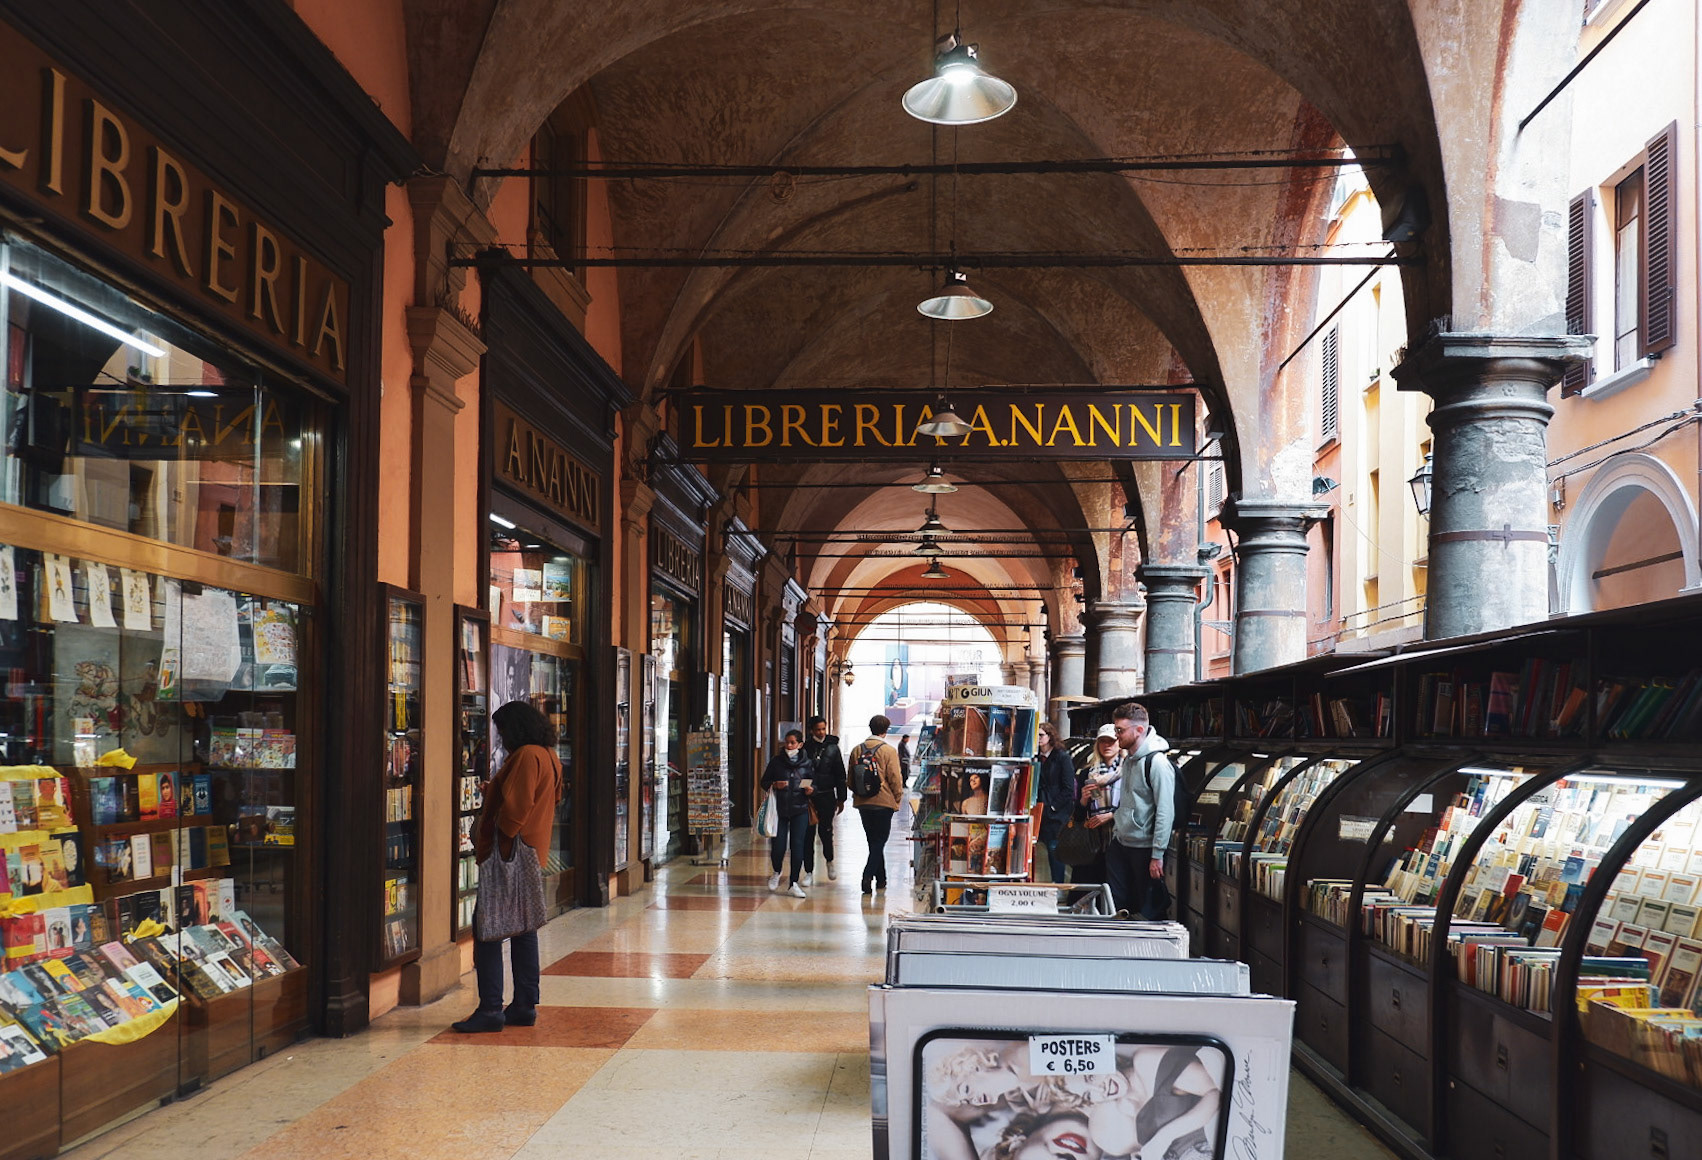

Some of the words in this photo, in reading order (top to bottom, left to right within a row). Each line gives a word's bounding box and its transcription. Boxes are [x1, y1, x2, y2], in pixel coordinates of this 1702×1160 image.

[692, 404, 945, 448] LIBRERIA
[657, 527, 700, 590] LIBRERIA
[1041, 1040, 1101, 1056] POSTERS
[1046, 1061, 1056, 1071] €
[1064, 1059, 1095, 1075] 6,50
